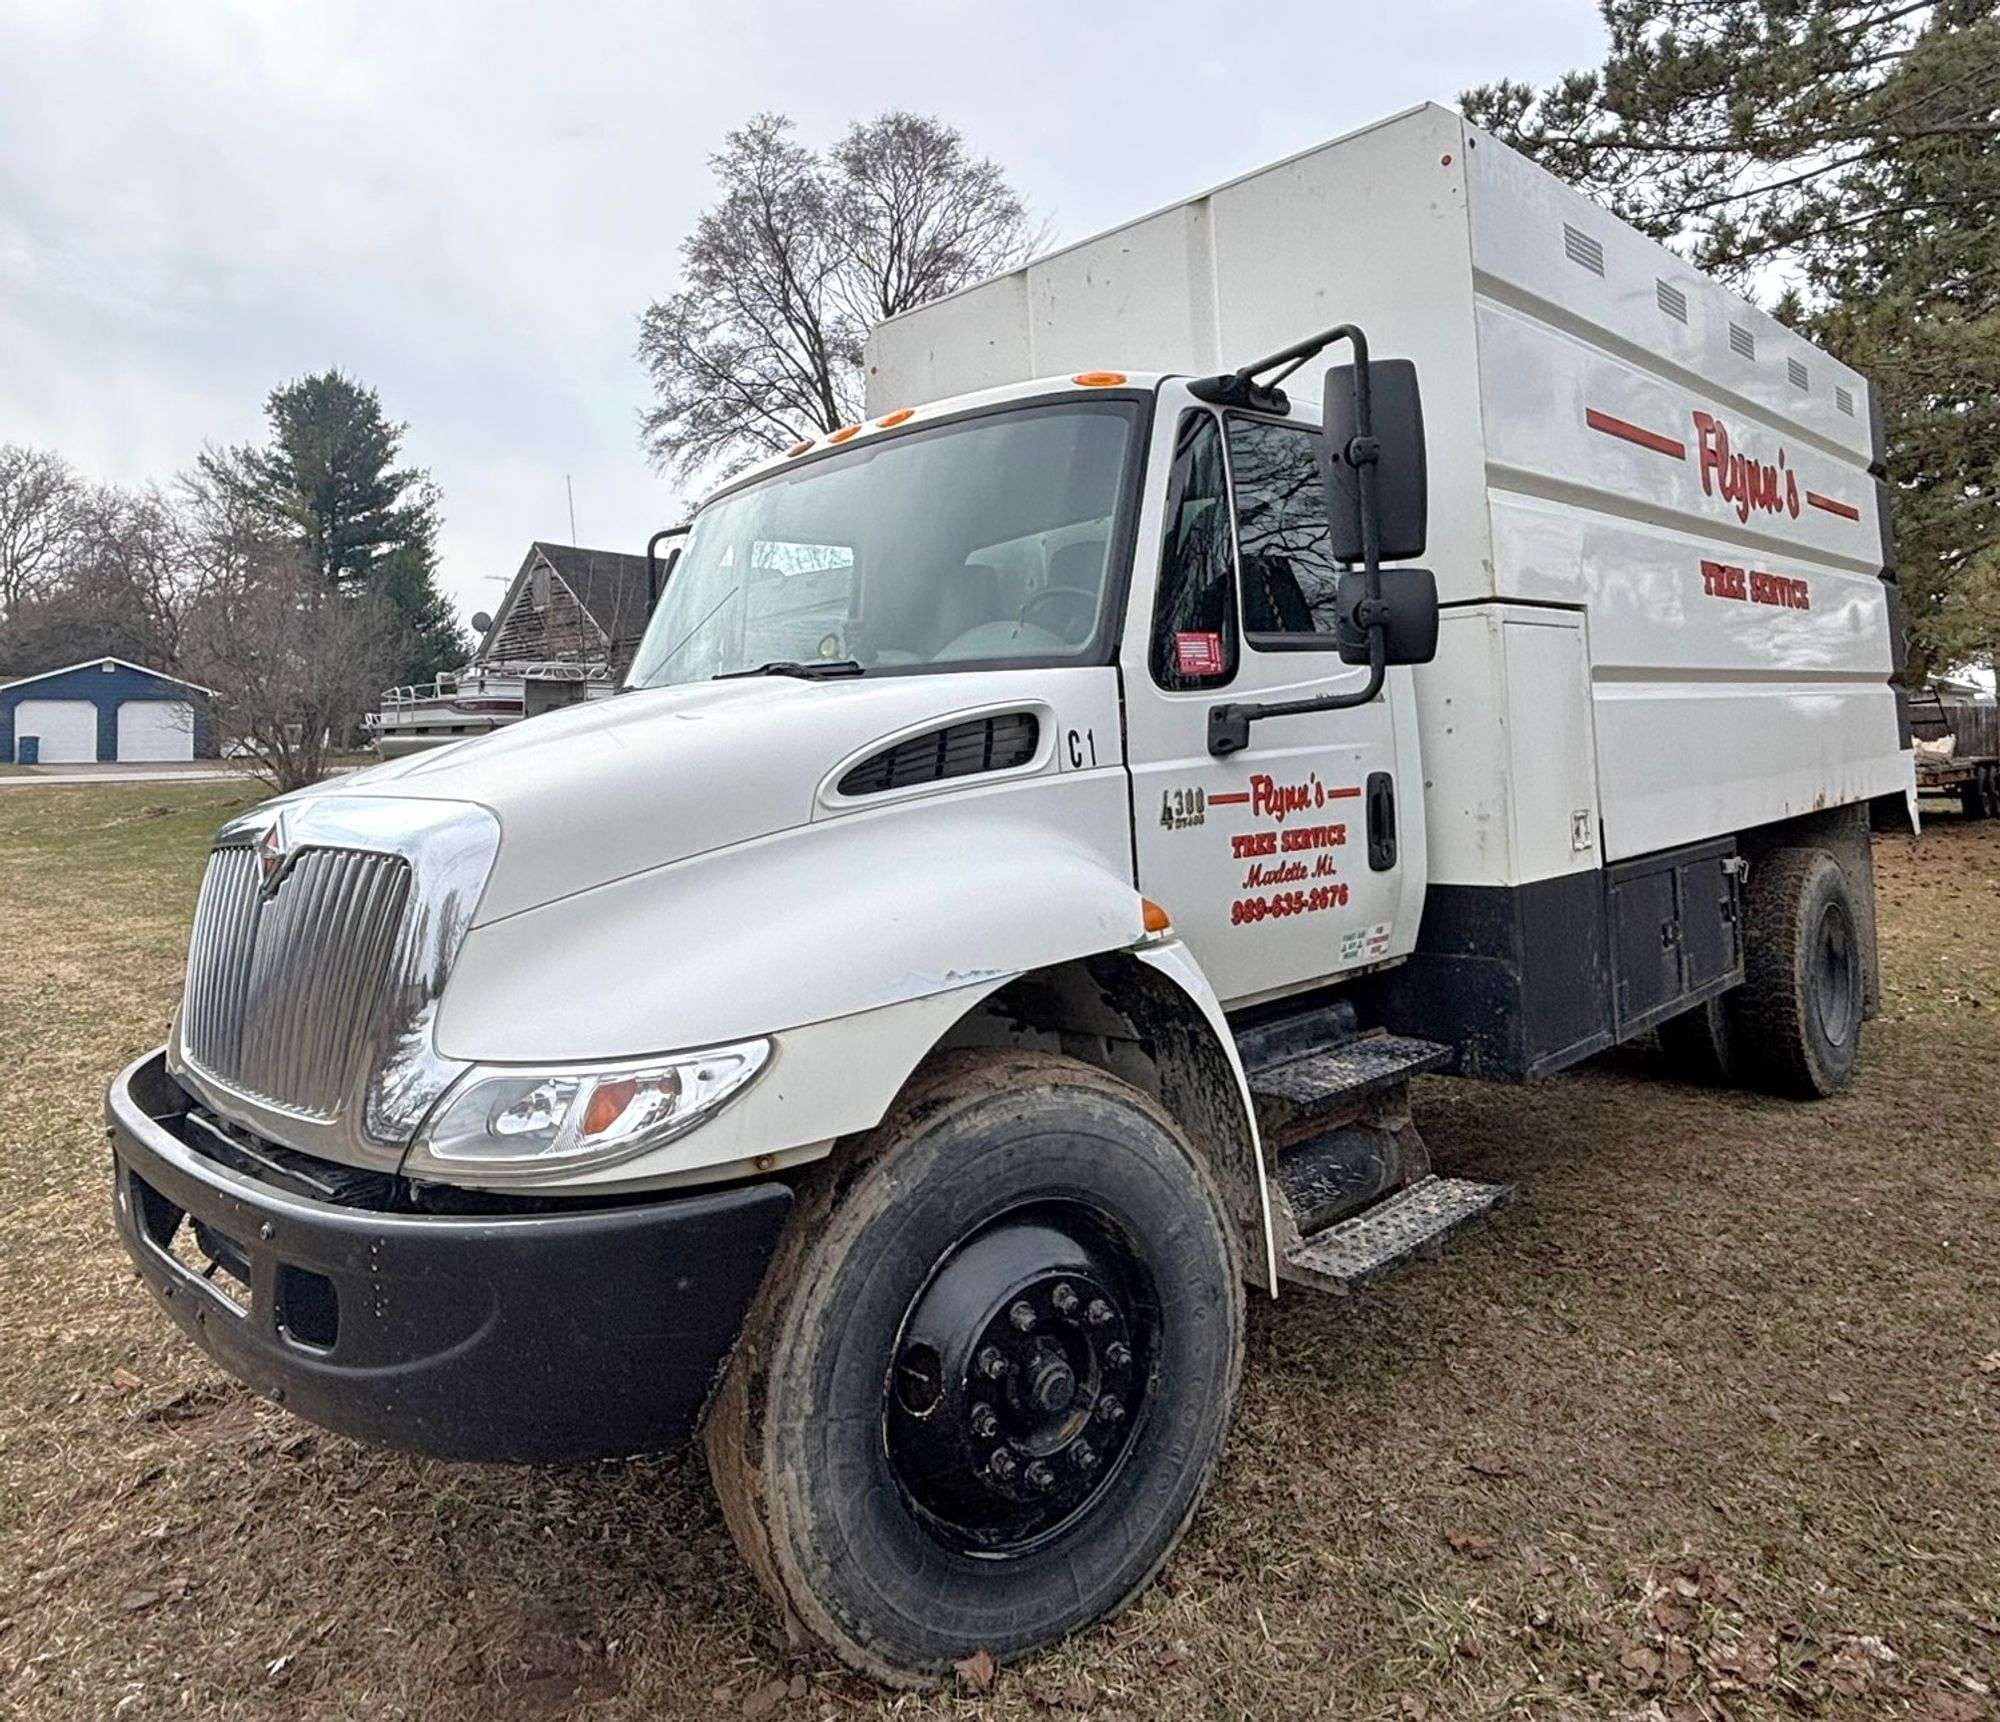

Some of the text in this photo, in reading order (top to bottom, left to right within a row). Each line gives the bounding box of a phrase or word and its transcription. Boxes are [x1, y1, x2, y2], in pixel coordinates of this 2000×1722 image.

[1692, 410, 1800, 524] Flynn's
[1700, 560, 1810, 610] TREE SERVICE
[1250, 771, 1326, 823] Flynn's
[1231, 824, 1346, 859] TREE SERVICE
[1242, 859, 1308, 889] Marlette
[1230, 883, 1349, 925] 989-635-2676
